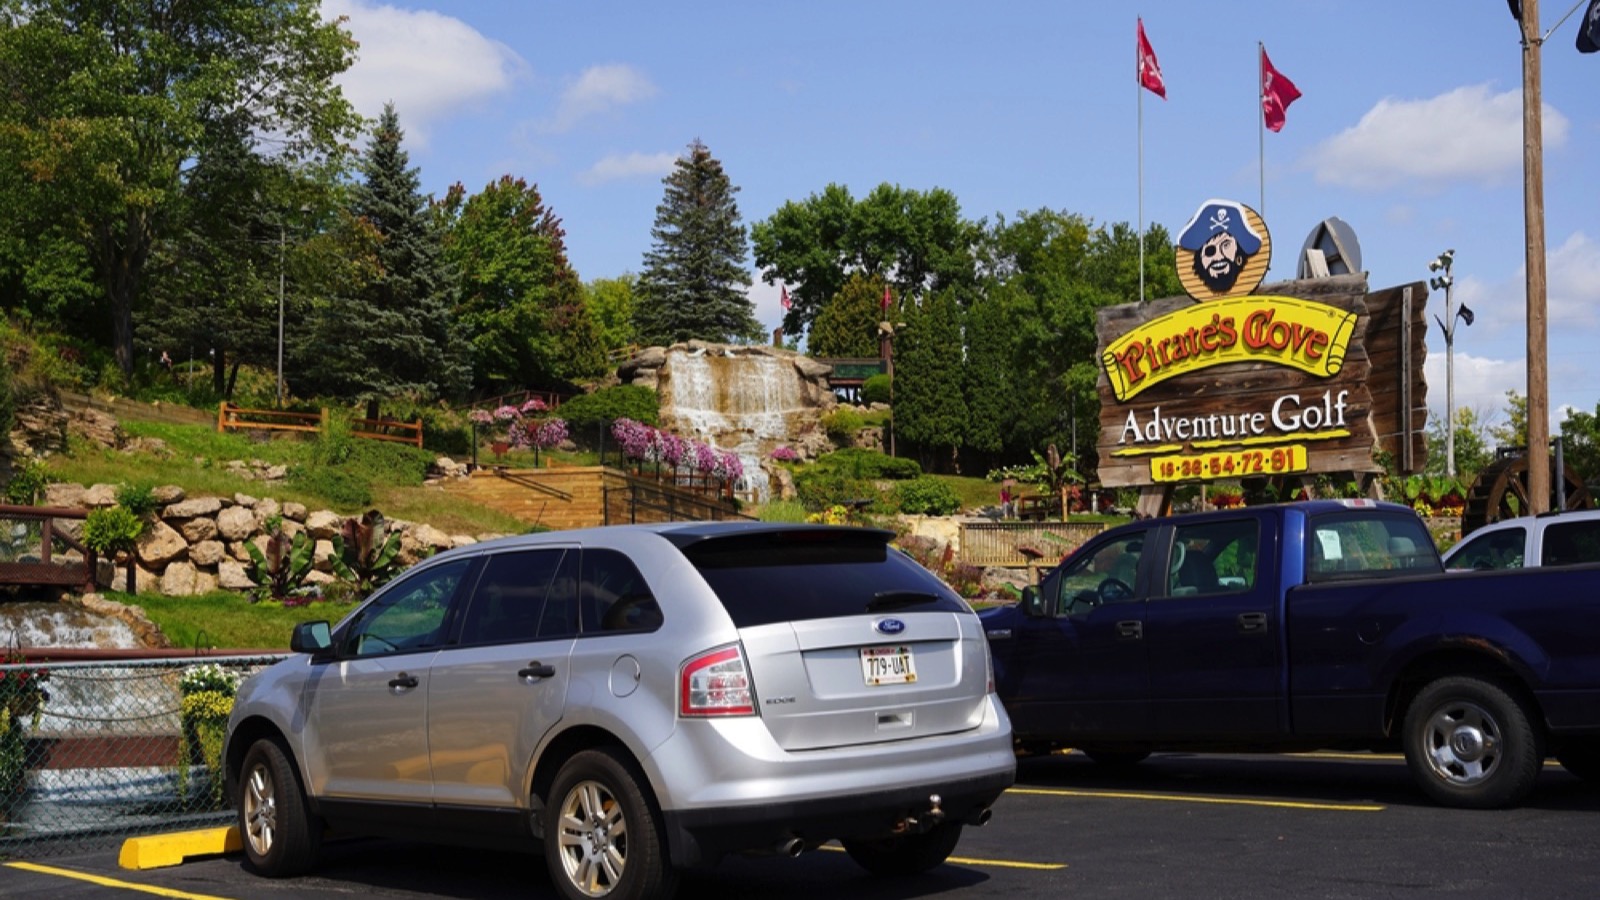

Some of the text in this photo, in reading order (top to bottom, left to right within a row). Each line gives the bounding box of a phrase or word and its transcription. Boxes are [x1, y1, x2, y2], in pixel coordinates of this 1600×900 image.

[1116, 309, 1328, 383] Pirate's Cove
[1118, 390, 1349, 444] Adventure Golf
[883, 620, 901, 631] Ford
[867, 656, 910, 676] 779-UAT
